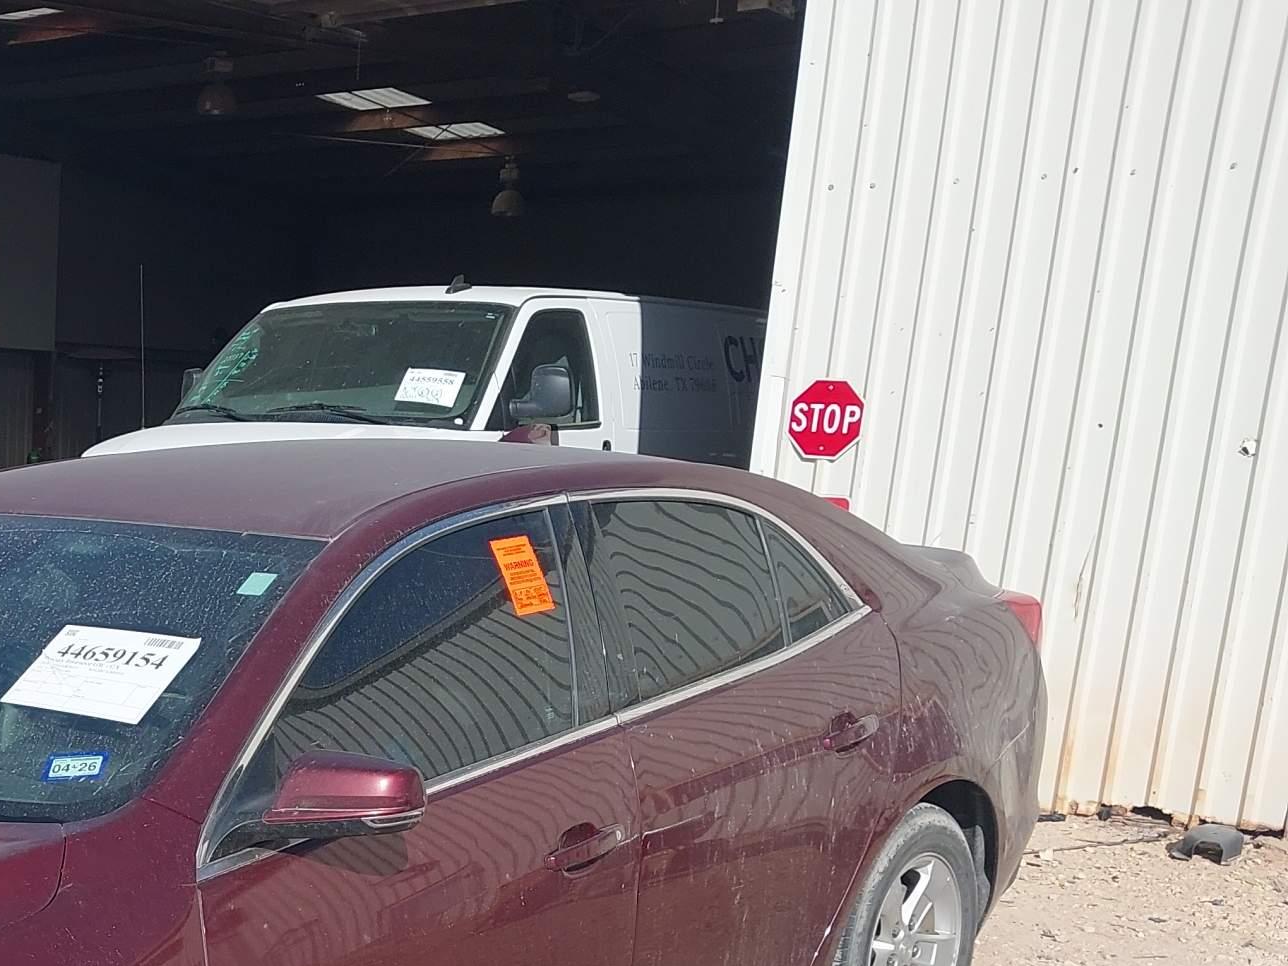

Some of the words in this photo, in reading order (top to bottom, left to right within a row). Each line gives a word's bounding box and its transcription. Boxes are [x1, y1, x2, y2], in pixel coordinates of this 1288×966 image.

[629, 352, 638, 368] 17
[724, 335, 763, 383] CH
[791, 402, 861, 434] STOP
[57, 643, 170, 670] 44659154
